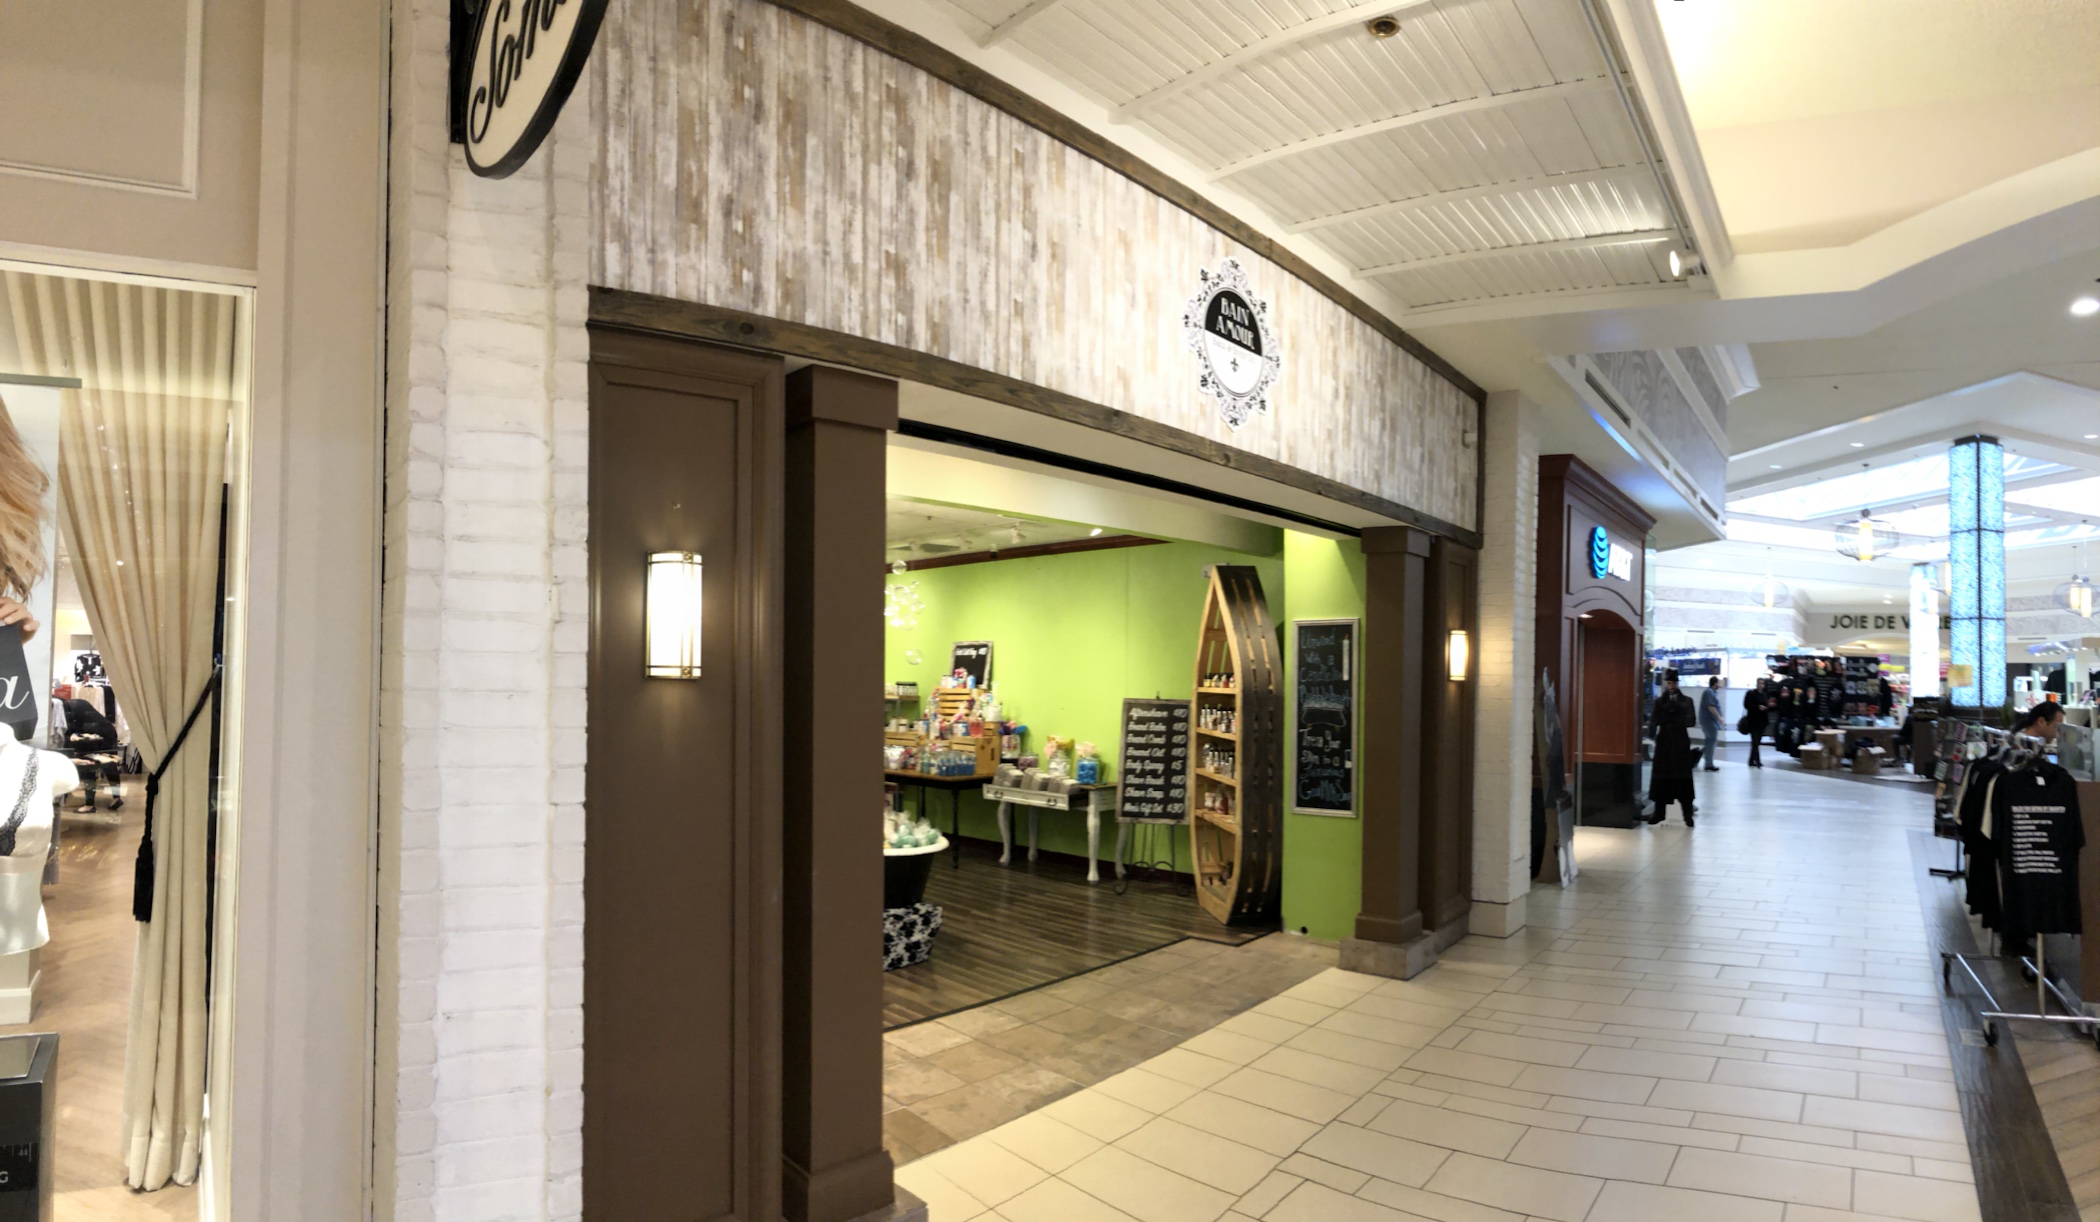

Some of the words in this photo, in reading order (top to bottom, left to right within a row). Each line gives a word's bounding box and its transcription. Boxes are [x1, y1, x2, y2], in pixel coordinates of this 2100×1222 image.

[1221, 297, 1249, 325] BAIN
[1830, 615, 1868, 629] JOIE
[1874, 615, 1896, 629] DE
